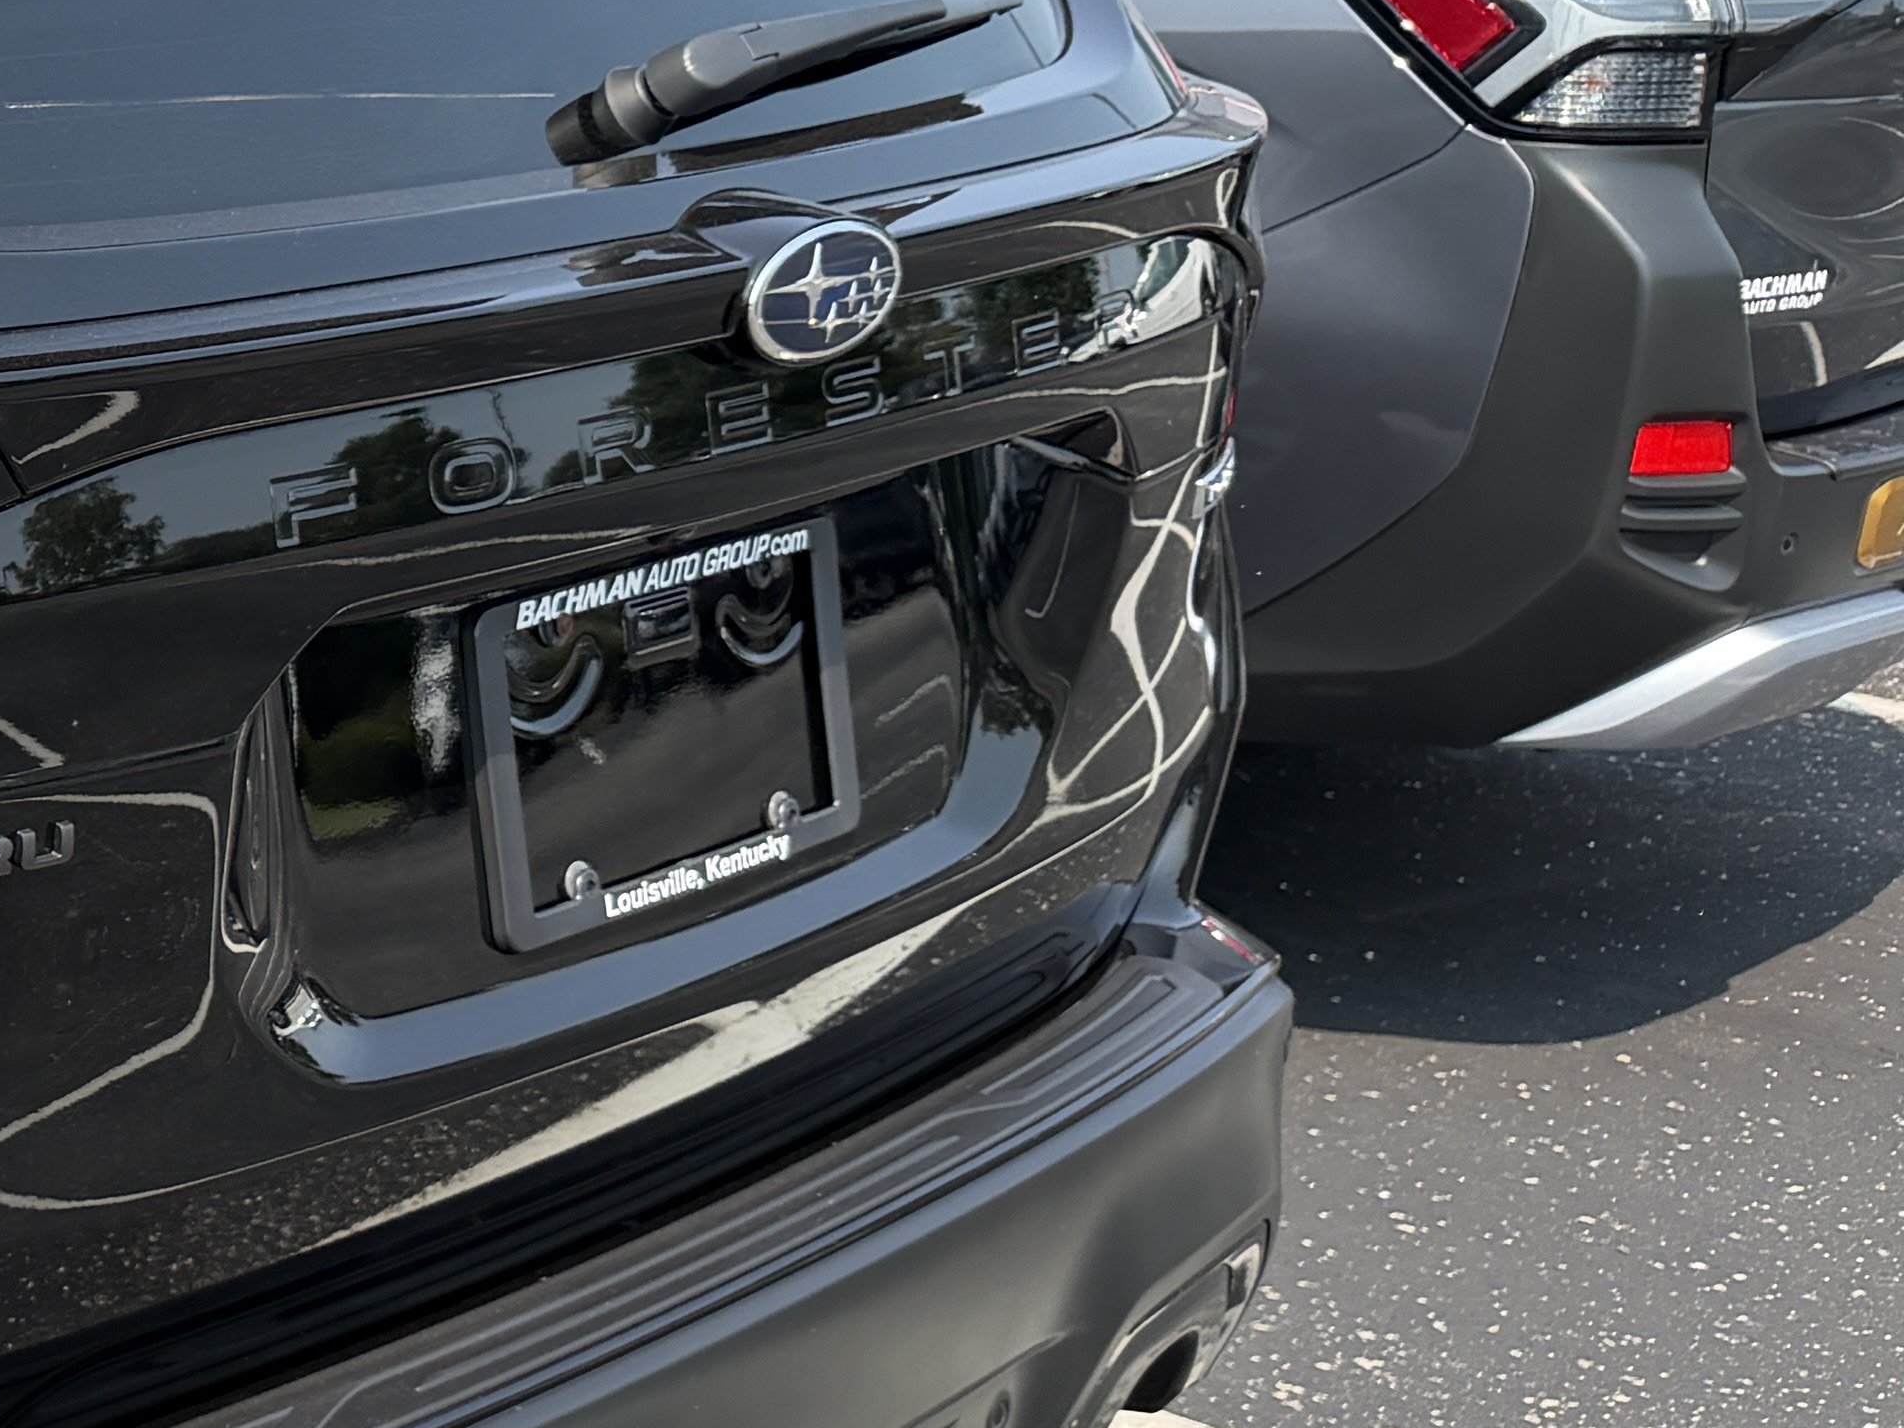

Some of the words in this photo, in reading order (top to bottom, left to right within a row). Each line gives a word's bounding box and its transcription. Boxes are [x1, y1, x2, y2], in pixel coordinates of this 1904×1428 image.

[1778, 291, 1824, 311] GROUP
[268, 287, 1143, 549] FORESTER
[515, 567, 645, 631] BACHMAN
[644, 552, 699, 591] AUTO
[702, 528, 809, 577] GROUP.com
[604, 866, 706, 918] Louisville,
[704, 834, 791, 882] Kentucky
